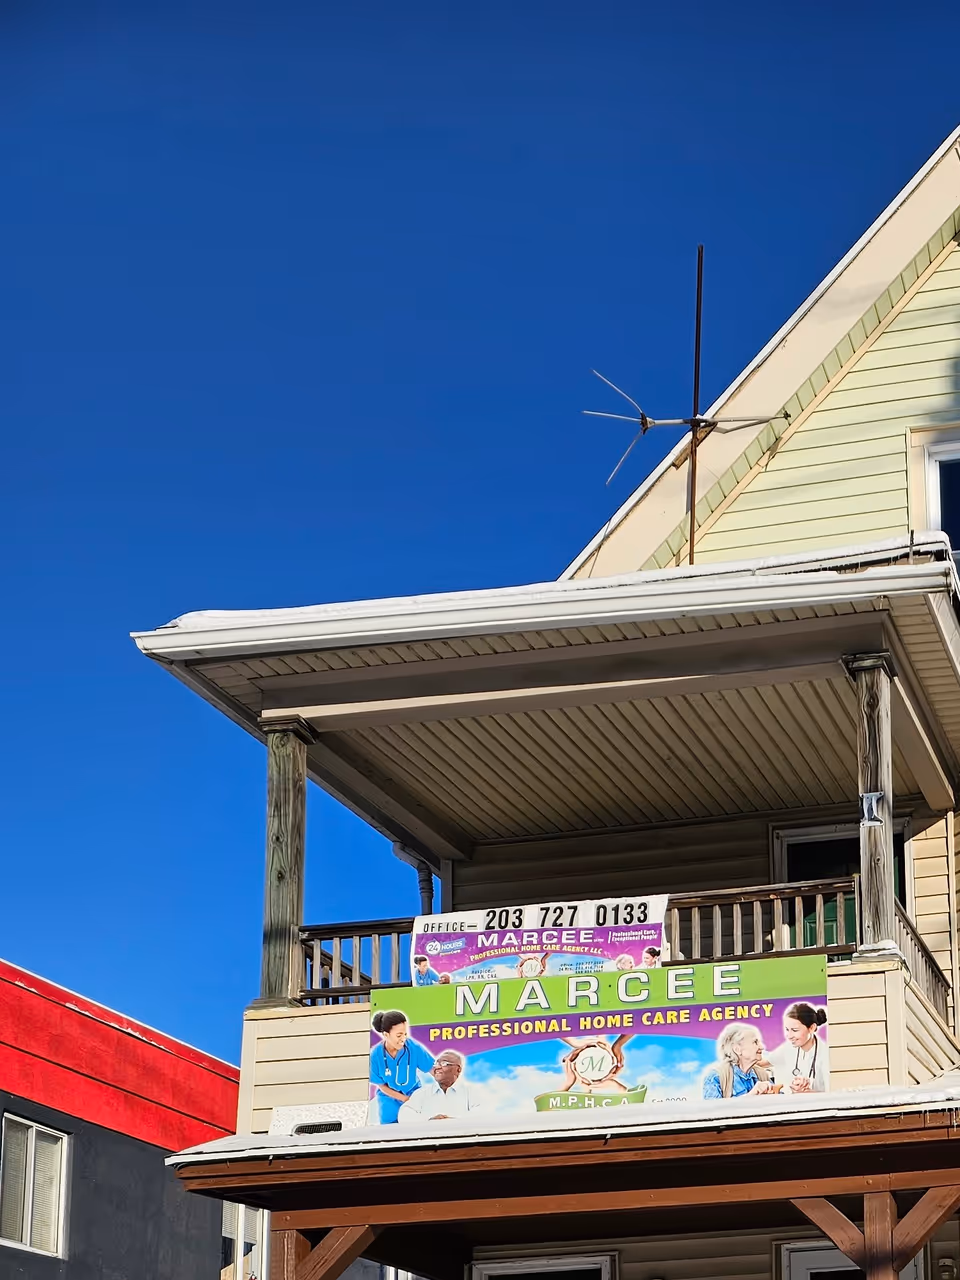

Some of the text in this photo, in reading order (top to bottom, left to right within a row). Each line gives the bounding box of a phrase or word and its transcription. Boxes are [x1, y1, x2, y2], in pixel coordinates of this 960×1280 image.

[485, 908, 524, 930] 203
[540, 905, 578, 927] 727
[596, 902, 648, 927] 0133
[428, 941, 463, 952] 24 HOURS
[477, 930, 594, 948] MARCEE
[470, 946, 519, 961] PROFESSIONAL
[455, 964, 741, 1016] MARCEE
[429, 1003, 774, 1041] PROFESSIONAL HOME CARE AGENCY
[580, 1055, 605, 1074] M
